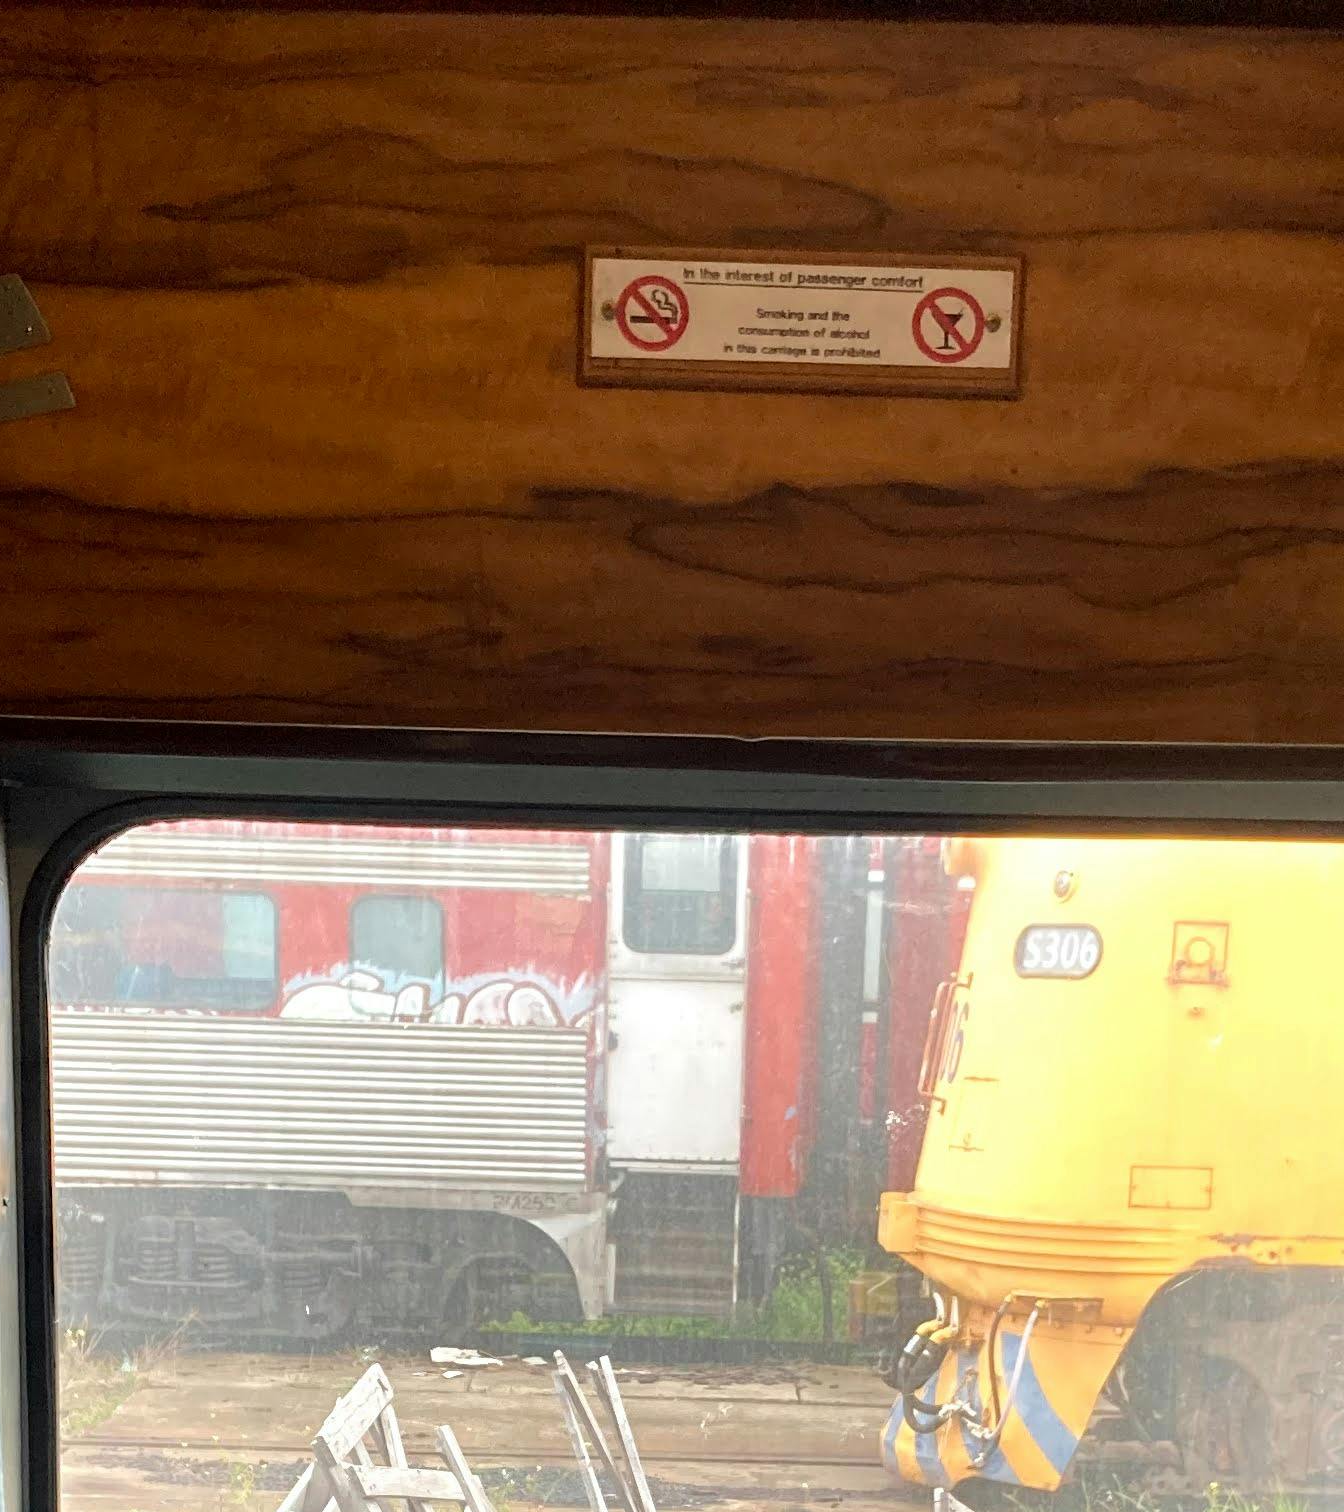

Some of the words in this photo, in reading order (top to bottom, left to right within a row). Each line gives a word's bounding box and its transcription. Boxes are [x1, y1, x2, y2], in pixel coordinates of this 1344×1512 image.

[682, 268, 695, 279] In
[700, 268, 720, 281] the
[725, 269, 774, 282] interest
[780, 271, 793, 283] of
[797, 273, 867, 288] passenger
[871, 275, 924, 288] comfort
[756, 308, 804, 322] Smoking
[807, 311, 828, 321] and
[831, 311, 850, 322] the
[738, 326, 810, 339] consumption
[813, 328, 826, 339] of
[830, 329, 870, 340] alcohol
[723, 343, 734, 353] in
[737, 343, 757, 354] this
[761, 345, 807, 357] carriage
[811, 347, 821, 357] is
[824, 347, 881, 360] prohibited
[1022, 930, 1099, 970] S306
